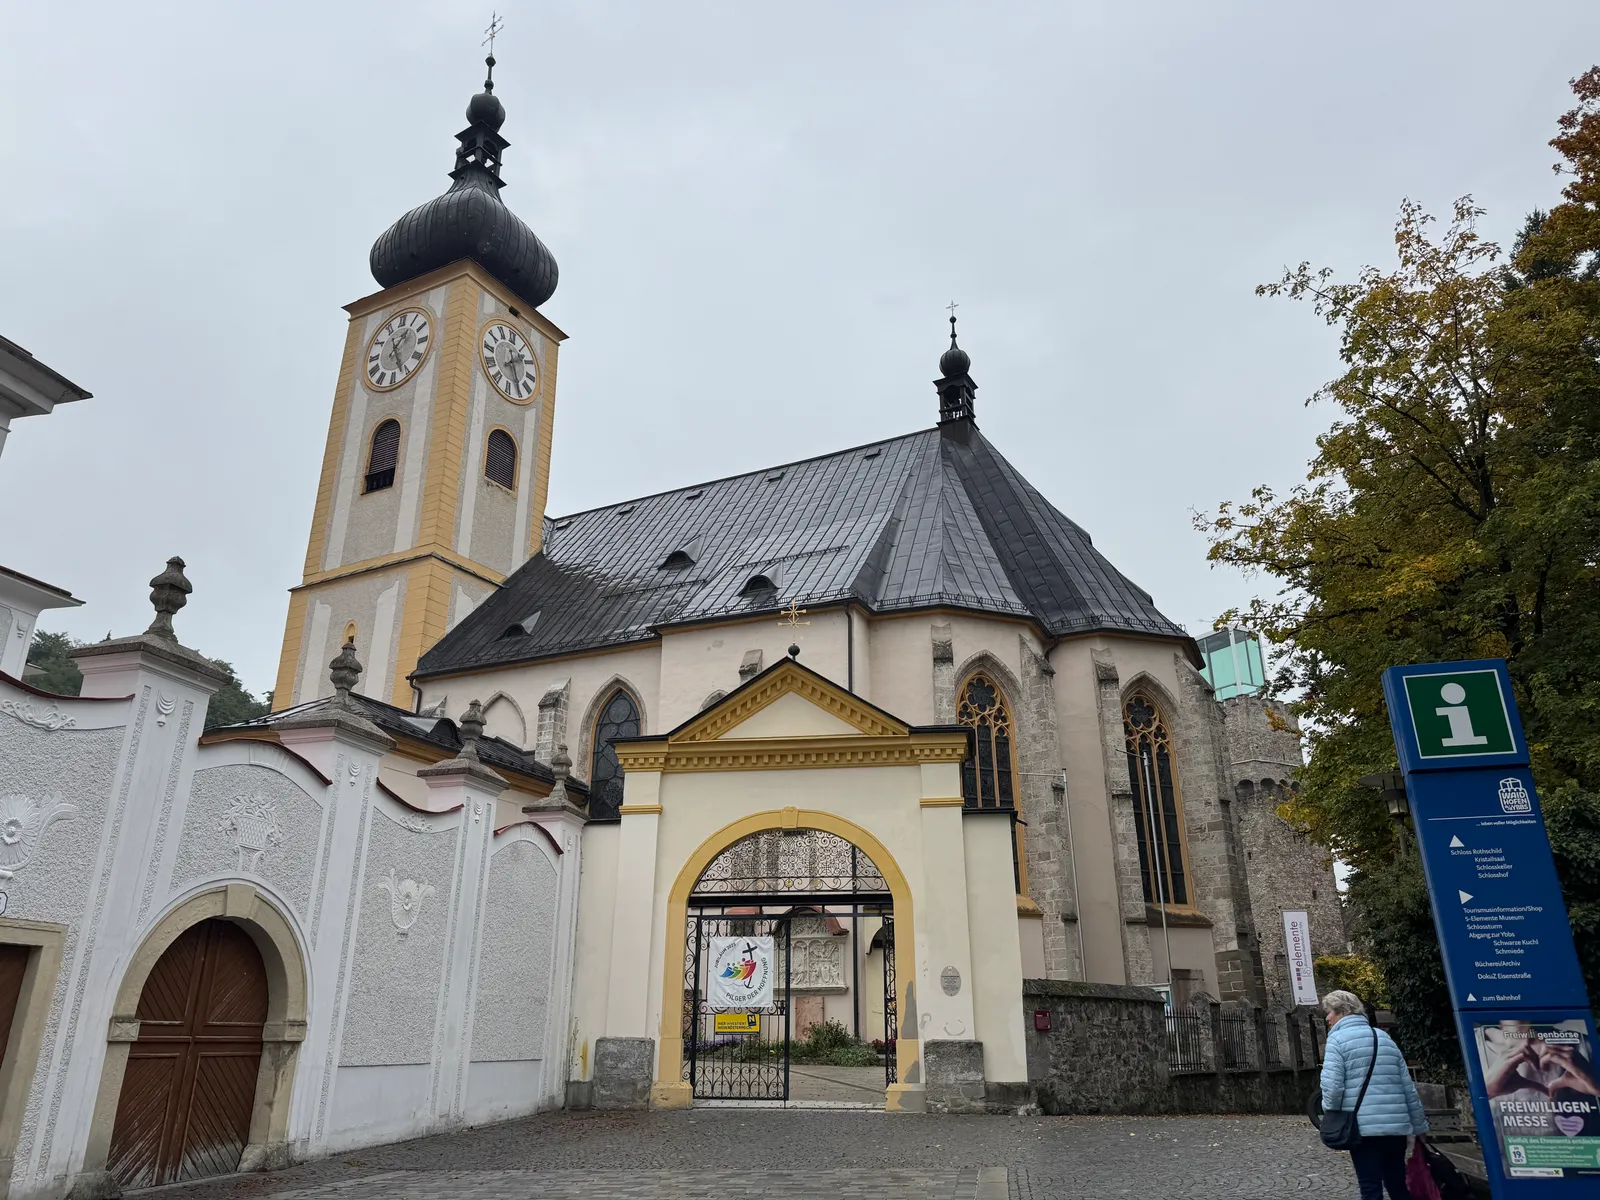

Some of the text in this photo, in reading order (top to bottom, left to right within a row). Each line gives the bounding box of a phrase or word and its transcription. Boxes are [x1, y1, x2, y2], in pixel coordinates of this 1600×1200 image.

[1463, 906, 1543, 914] Tourismusinformation/Shop
[1290, 921, 1303, 967] elemente
[715, 947, 727, 968] JUBILÄUM
[726, 957, 768, 1001] PILGER DER HOFFNUNG
[1500, 1101, 1597, 1113] FREIWILLIGEN-
[1503, 1115, 1549, 1127] MESSE
